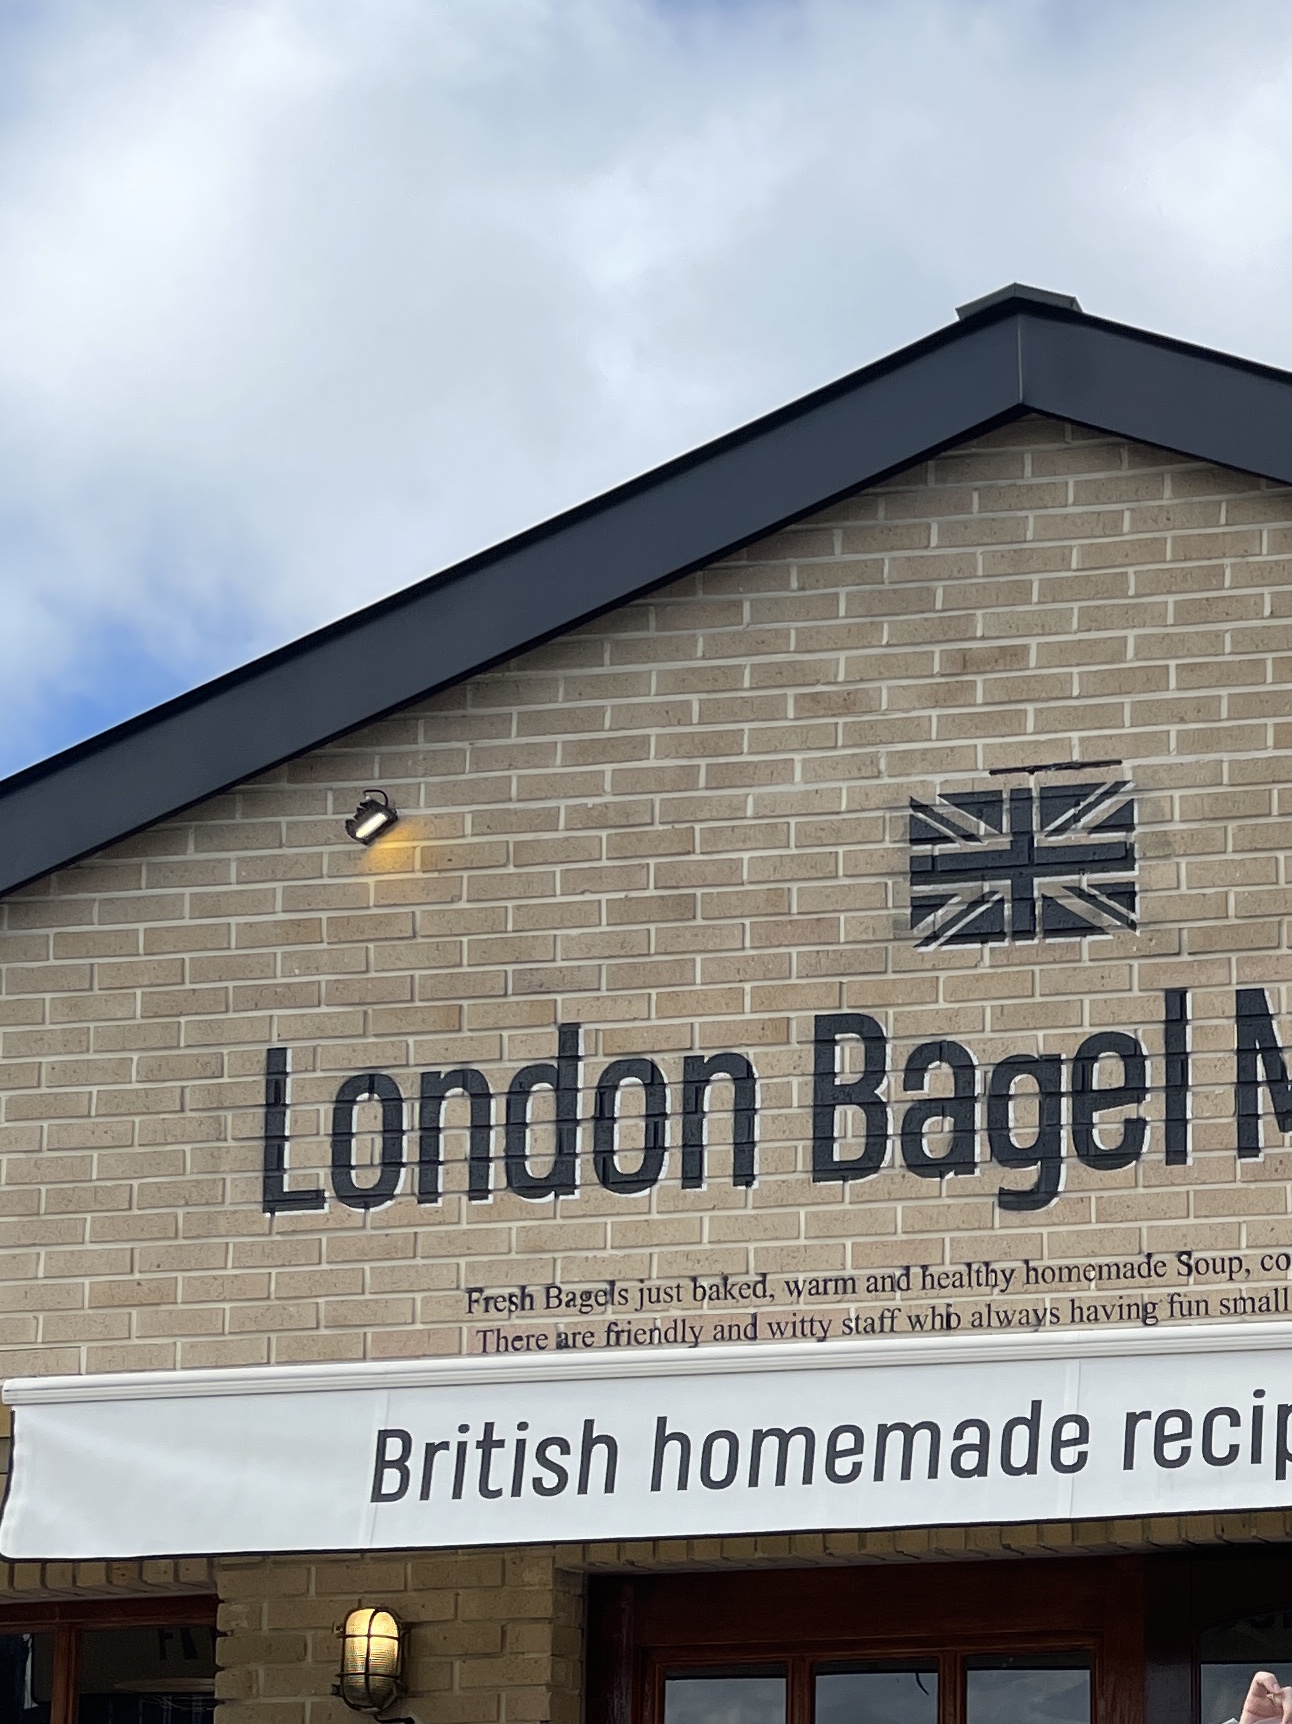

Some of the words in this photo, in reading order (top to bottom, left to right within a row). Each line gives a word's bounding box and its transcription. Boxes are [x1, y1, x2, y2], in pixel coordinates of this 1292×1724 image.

[262, 1023, 759, 1215] London
[812, 989, 1190, 1211] Bagel
[465, 1286, 535, 1315] Fresh
[544, 1280, 629, 1315] Bagels
[634, 1279, 683, 1312] just
[692, 1273, 775, 1302] baked,
[784, 1274, 857, 1297] warm
[866, 1266, 911, 1293] and
[921, 1261, 1015, 1293] healthy
[1024, 1253, 1167, 1285] homemade
[1176, 1249, 1251, 1279] Soup,
[476, 1329, 548, 1354] There
[556, 1327, 594, 1350] are
[604, 1319, 704, 1349] friendly
[712, 1312, 758, 1341] and
[767, 1312, 832, 1342] witty
[841, 1307, 901, 1336] staff
[906, 1302, 961, 1332] who
[970, 1303, 1060, 1332] always
[1069, 1295, 1159, 1326] having
[1167, 1291, 1209, 1319] fun
[1219, 1287, 1288, 1315] small
[370, 1418, 619, 1503] British
[650, 1399, 1090, 1492] homemade
